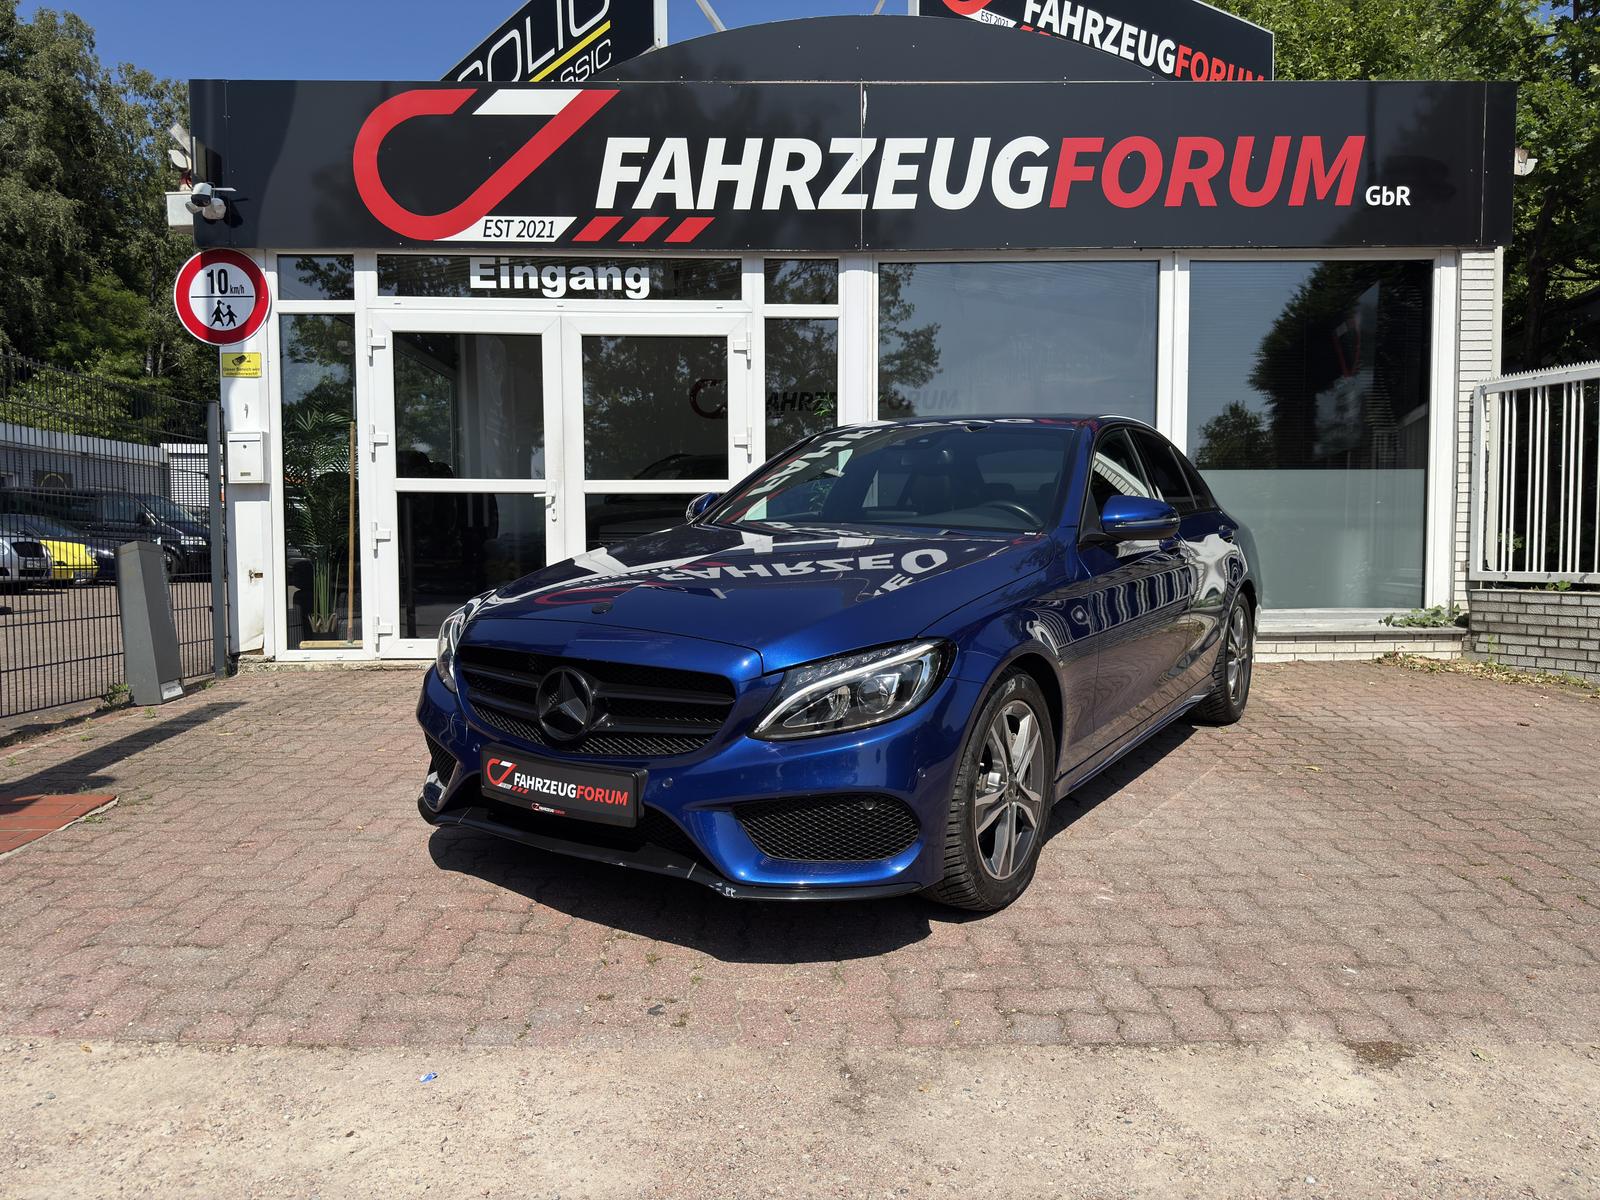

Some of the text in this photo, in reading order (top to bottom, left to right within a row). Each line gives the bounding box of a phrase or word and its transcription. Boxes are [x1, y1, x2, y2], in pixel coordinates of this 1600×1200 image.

[595, 134, 1411, 211] FAHRZEUGFORUM GbR
[483, 219, 556, 239] EST 2021
[206, 268, 245, 295] 10 km/h
[469, 256, 651, 300] Eingang
[513, 772, 629, 807] FAHRZEUGFORUM
